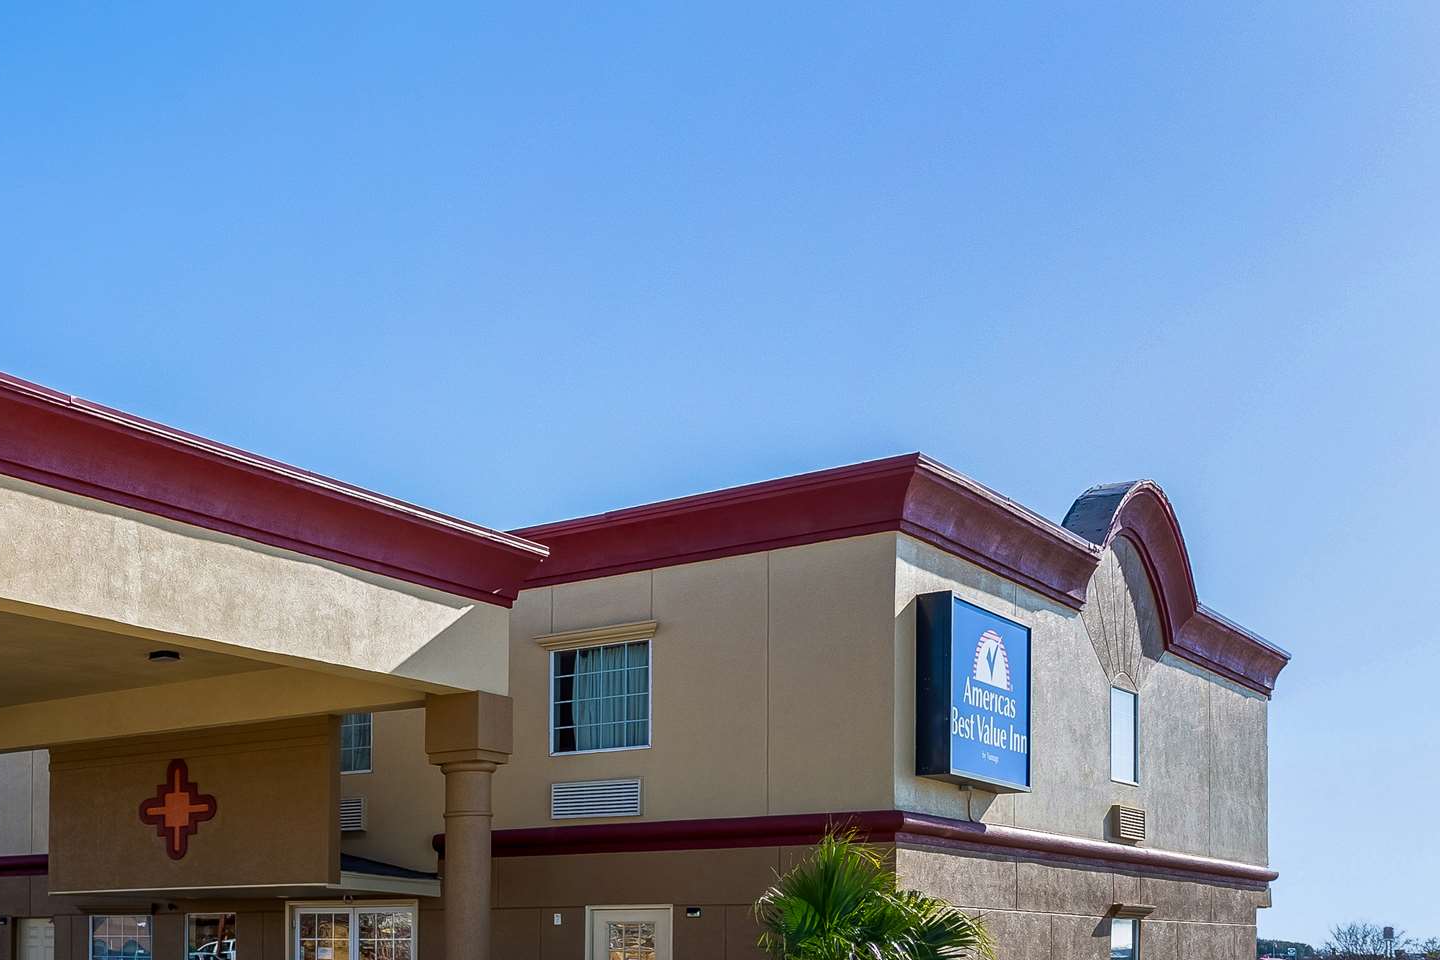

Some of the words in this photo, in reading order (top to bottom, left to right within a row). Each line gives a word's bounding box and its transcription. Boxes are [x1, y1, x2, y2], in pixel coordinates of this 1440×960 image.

[963, 676, 1016, 719] Americas
[952, 706, 975, 741] Best
[976, 714, 1007, 749] Value
[1009, 724, 1027, 754] Inn
